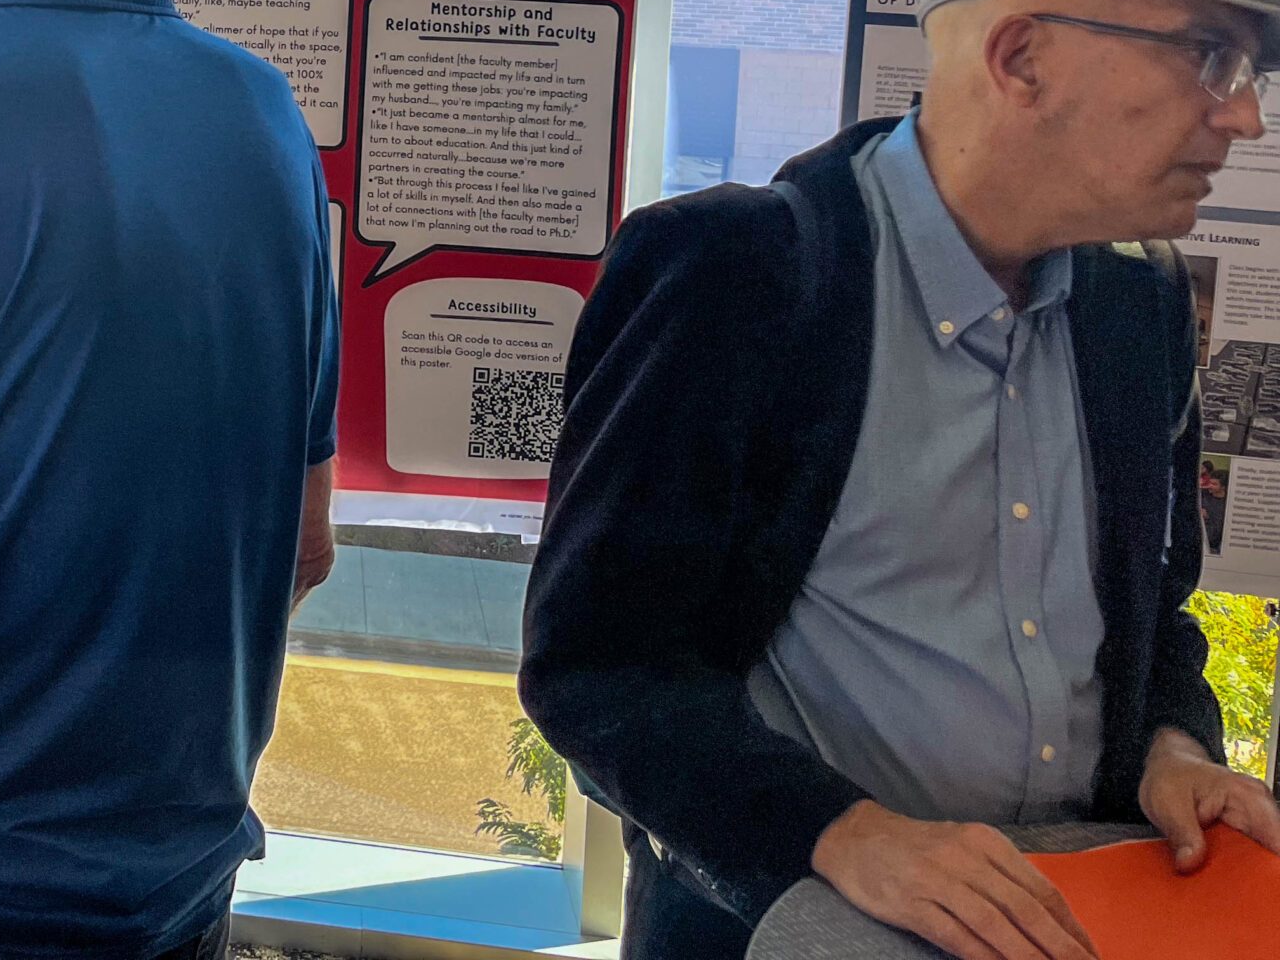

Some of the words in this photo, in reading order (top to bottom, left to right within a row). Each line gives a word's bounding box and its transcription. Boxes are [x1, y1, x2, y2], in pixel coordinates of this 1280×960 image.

[431, 3, 516, 21] Mentorship
[524, 7, 552, 21] and
[260, 24, 286, 40] hope
[289, 25, 309, 37] that
[322, 31, 340, 41] you
[386, 18, 490, 36] Relationships
[499, 24, 529, 37] with
[537, 25, 596, 42] Faculty
[290, 40, 306, 51] the
[273, 53, 293, 64] that
[296, 54, 327, 69] you're
[408, 52, 454, 64] confident
[479, 55, 512, 70] faculty
[298, 67, 324, 79] 100%
[373, 64, 424, 76] influenced
[427, 67, 447, 78] and
[449, 68, 497, 83] impacted
[534, 72, 554, 83] and
[567, 75, 586, 85] turn
[304, 82, 320, 94] the
[372, 78, 393, 89] with
[413, 81, 449, 95] getting
[507, 85, 536, 100] you're
[319, 101, 339, 109] can
[442, 95, 472, 110] you're
[390, 107, 406, 121] just
[409, 107, 450, 119] became
[463, 111, 516, 127] mentorship
[518, 114, 550, 125] almost
[553, 116, 567, 126] for
[371, 119, 388, 130] like
[396, 120, 420, 132] have
[520, 128, 539, 139] that
[370, 134, 389, 144] turn
[404, 135, 433, 146] about
[490, 140, 510, 151] And
[512, 141, 529, 152] this
[531, 143, 547, 157] just
[550, 143, 571, 155] kind
[369, 147, 414, 159] occurred
[510, 155, 538, 166] we're
[369, 161, 410, 176] partners
[424, 165, 466, 179] creating
[468, 166, 484, 177] the
[397, 175, 433, 191] through
[436, 178, 453, 189] this
[455, 183, 493, 195] process
[501, 182, 520, 193] feel
[523, 183, 540, 195] like
[542, 185, 559, 196] I've
[562, 186, 597, 202] gained
[377, 188, 390, 199] lot
[406, 190, 428, 201] skills
[477, 194, 496, 206] And
[498, 196, 520, 207] then
[522, 197, 542, 209] also
[545, 199, 573, 211] made
[367, 201, 379, 212] lot
[395, 204, 454, 216] connections
[457, 207, 477, 218] with
[501, 210, 534, 225] faculty
[366, 215, 386, 226] that
[412, 217, 426, 228] I'm
[429, 219, 471, 235] planning
[474, 223, 489, 233] out
[492, 223, 508, 234] the
[510, 224, 534, 235] road
[1210, 233, 1261, 246] LEARNING
[448, 299, 536, 318] Accessibility
[402, 329, 426, 341] Scan
[429, 331, 444, 342] this
[465, 333, 490, 345] code
[506, 340, 539, 348] access
[401, 342, 452, 355] accessible
[455, 346, 492, 361] Google
[494, 348, 514, 360] doc
[516, 351, 550, 362] version
[401, 355, 417, 366] this
